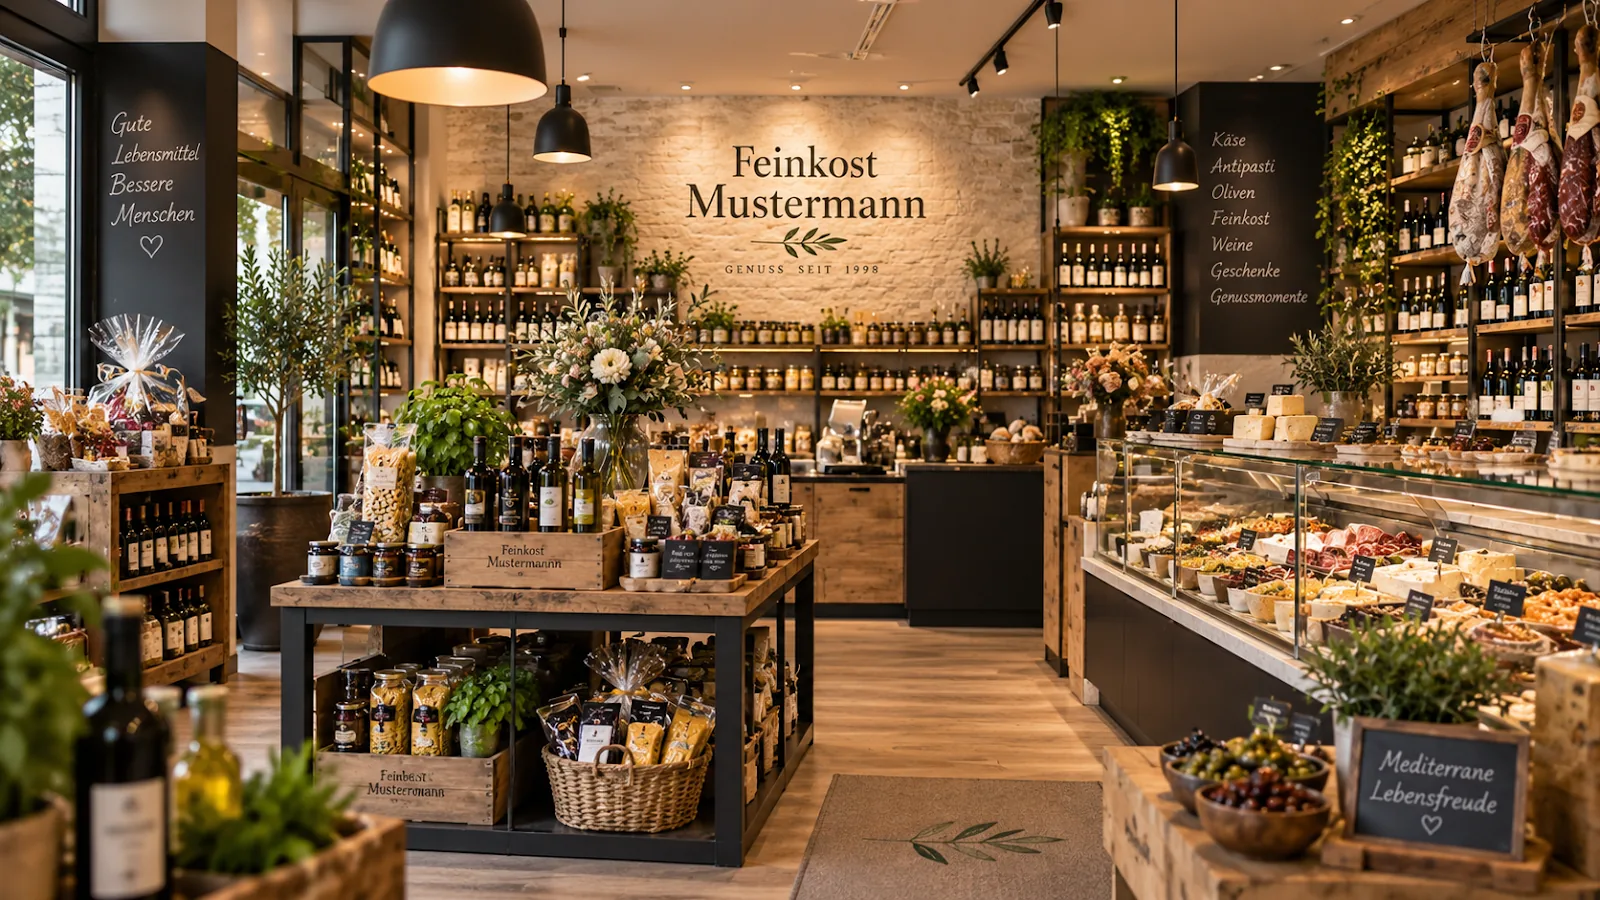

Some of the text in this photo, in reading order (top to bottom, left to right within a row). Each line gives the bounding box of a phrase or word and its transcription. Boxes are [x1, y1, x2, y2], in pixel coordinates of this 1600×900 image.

[110, 111, 152, 138] Gute
[1211, 131, 1247, 148] Käse
[111, 142, 201, 165] Lebensmittel
[732, 145, 879, 178] Feinkost
[1210, 156, 1276, 179] Antipasti
[109, 172, 174, 196] Bessere
[1211, 183, 1256, 200] Oliven
[685, 183, 927, 219] Mustermann
[110, 201, 196, 228] Menschen
[1211, 208, 1271, 226] Feinkost
[1211, 235, 1254, 252] Weine
[724, 264, 880, 275] GENUSS SEIT 1998
[1210, 261, 1281, 281] Geschenke
[1210, 287, 1309, 306] Genussmomente
[501, 544, 545, 556] Feinkost
[1377, 749, 1495, 783] Mediterrane
[1370, 779, 1497, 815] Lebensfreude
